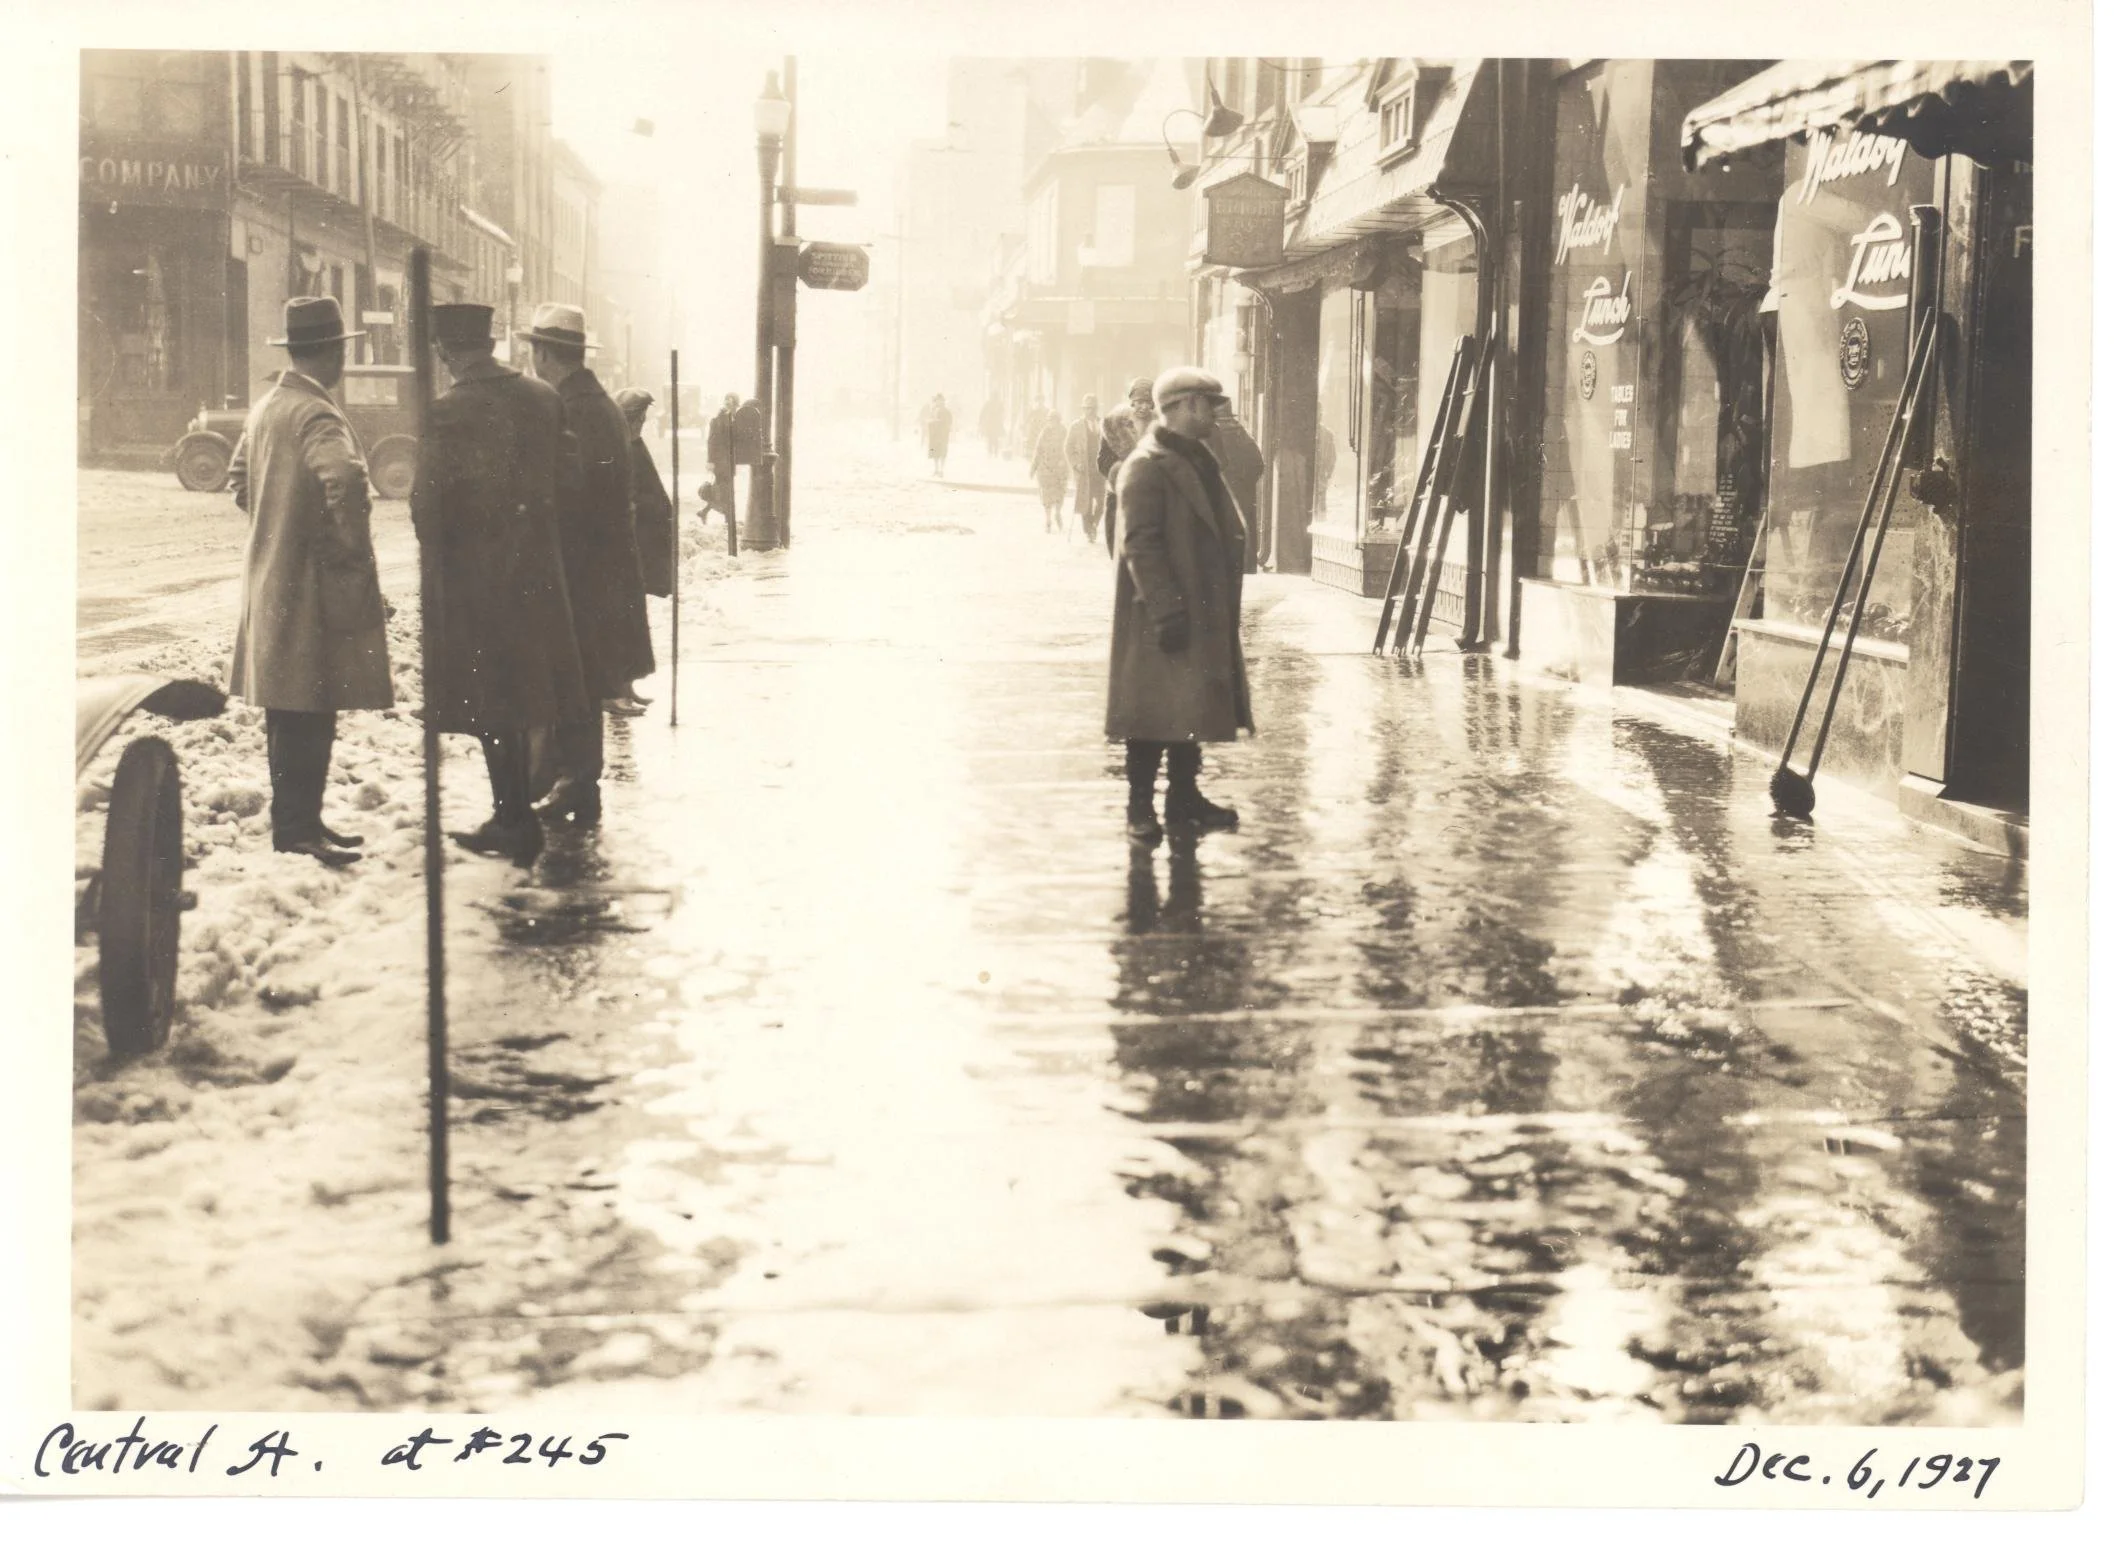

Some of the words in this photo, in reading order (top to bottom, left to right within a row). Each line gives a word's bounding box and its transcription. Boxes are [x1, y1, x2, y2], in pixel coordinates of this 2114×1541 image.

[79, 156, 220, 191] COMPANY
[1554, 182, 1625, 265] Waldorf
[1830, 212, 1912, 310] Lun
[1572, 270, 1632, 346] Lunch
[35, 1417, 217, 1476] Central
[227, 1431, 321, 1476] St.
[382, 1428, 453, 1470] at
[455, 1427, 629, 1467] #245
[1715, 1443, 1830, 1486] Dec.
